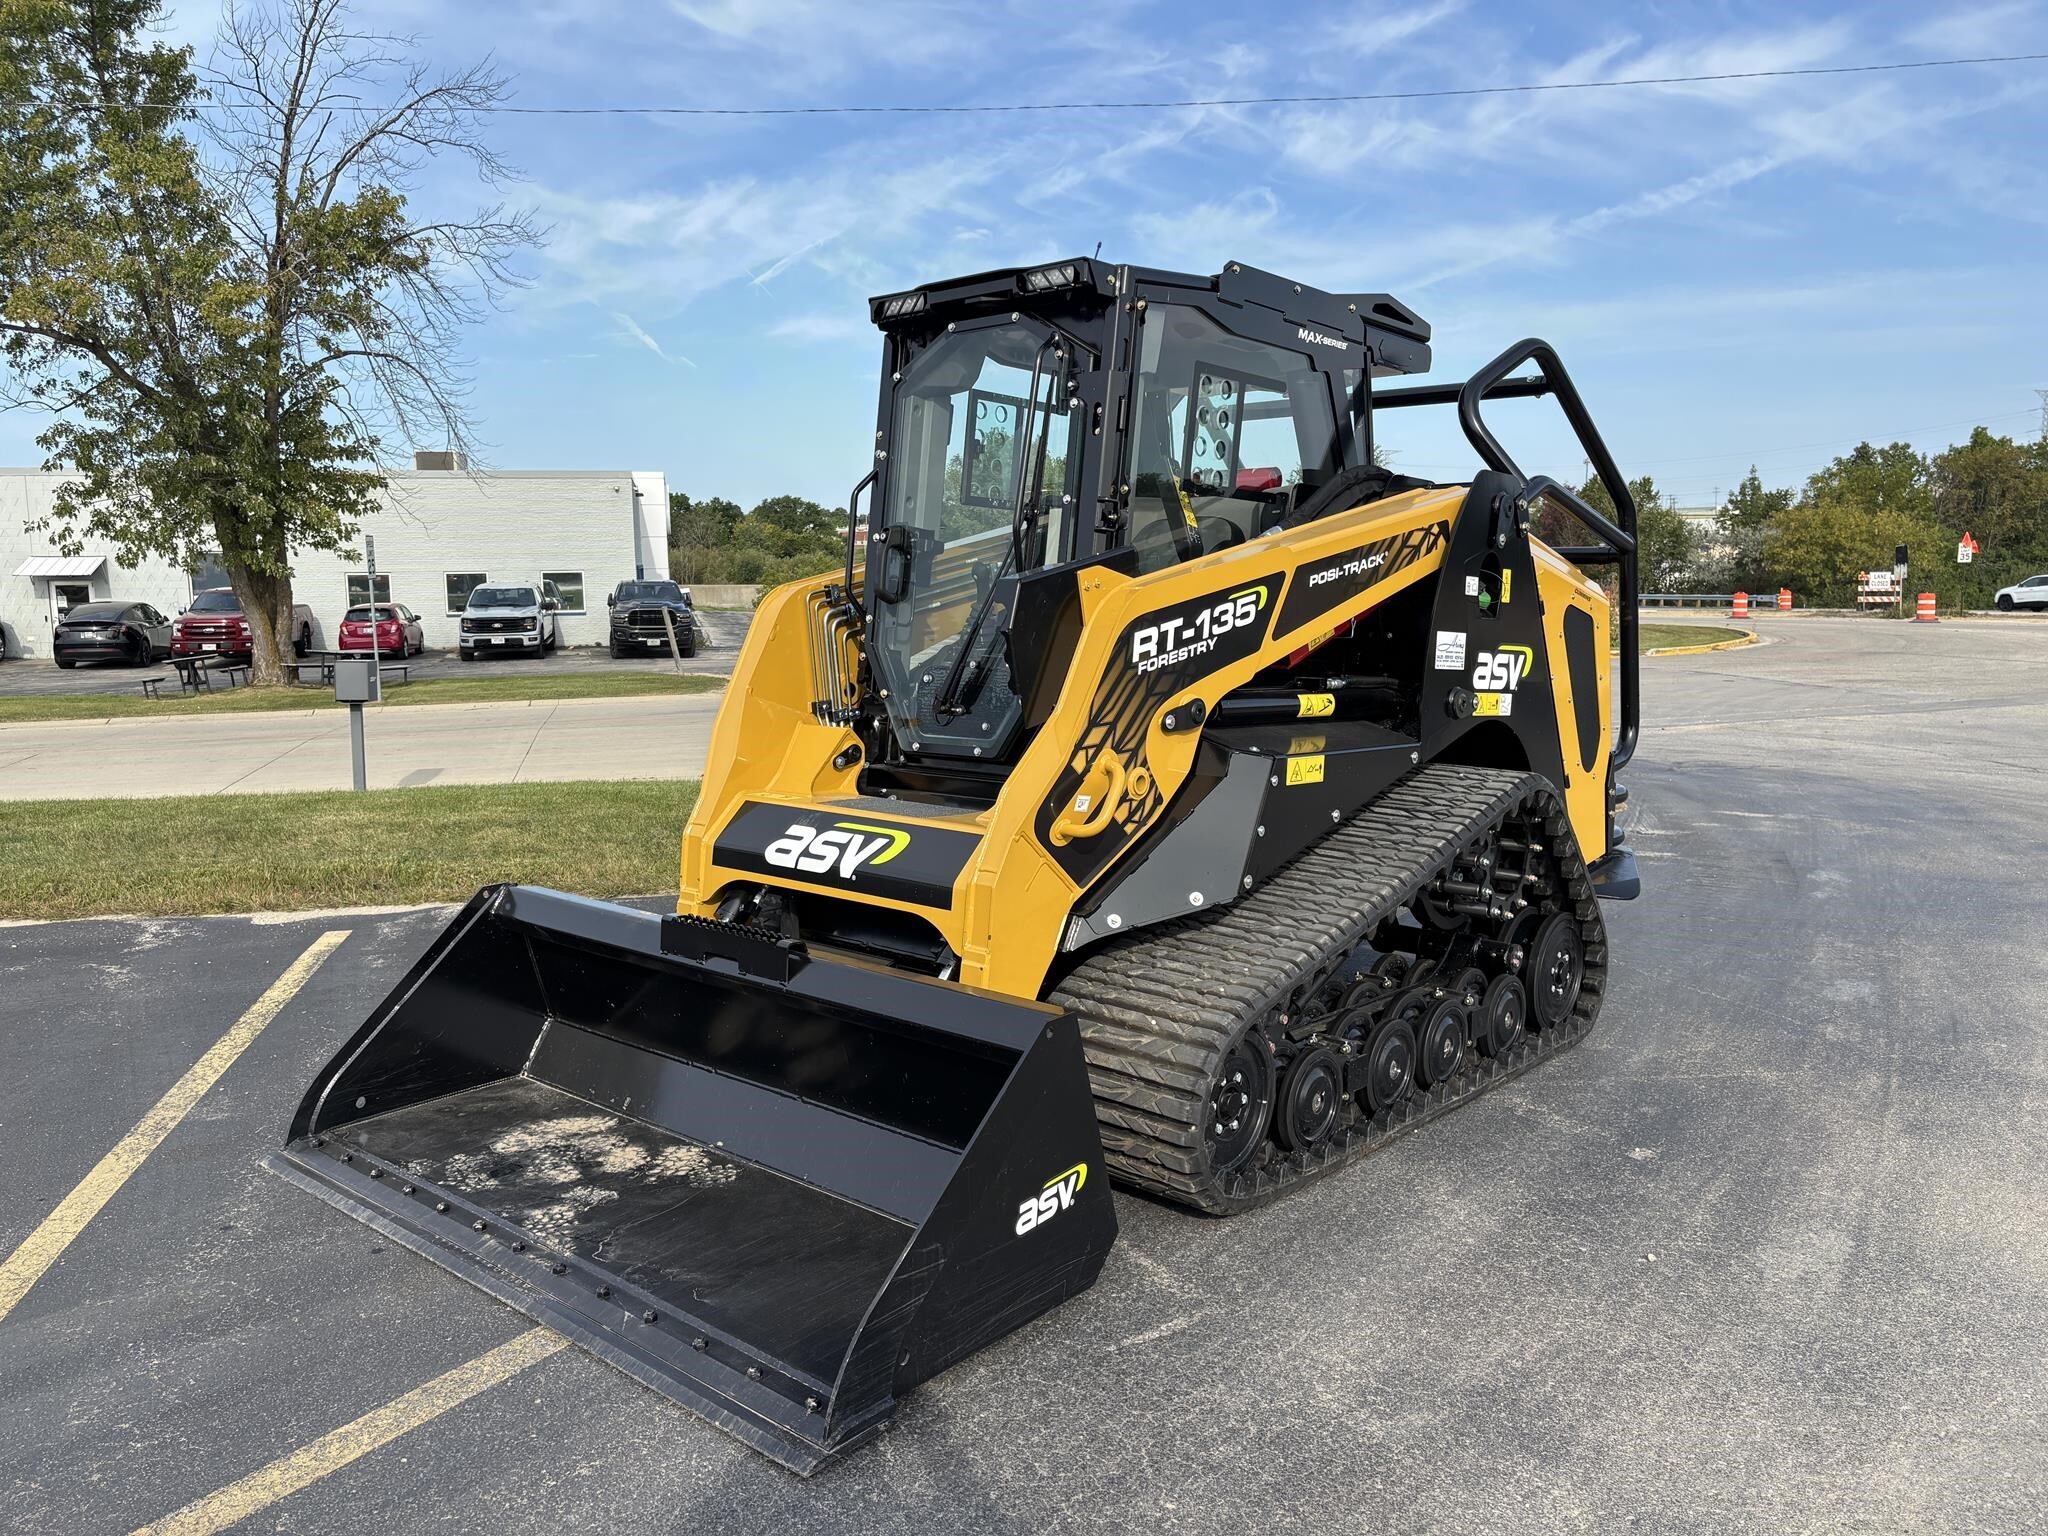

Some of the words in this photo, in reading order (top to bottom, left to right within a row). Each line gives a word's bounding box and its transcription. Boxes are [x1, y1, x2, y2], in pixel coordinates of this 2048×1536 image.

[1298, 328, 1348, 350] MAX-SERIES
[368, 558, 376, 575] 25
[1960, 553, 1970, 561] 35
[1131, 593, 1257, 664] RT-135
[1137, 636, 1219, 676] FORESTRY
